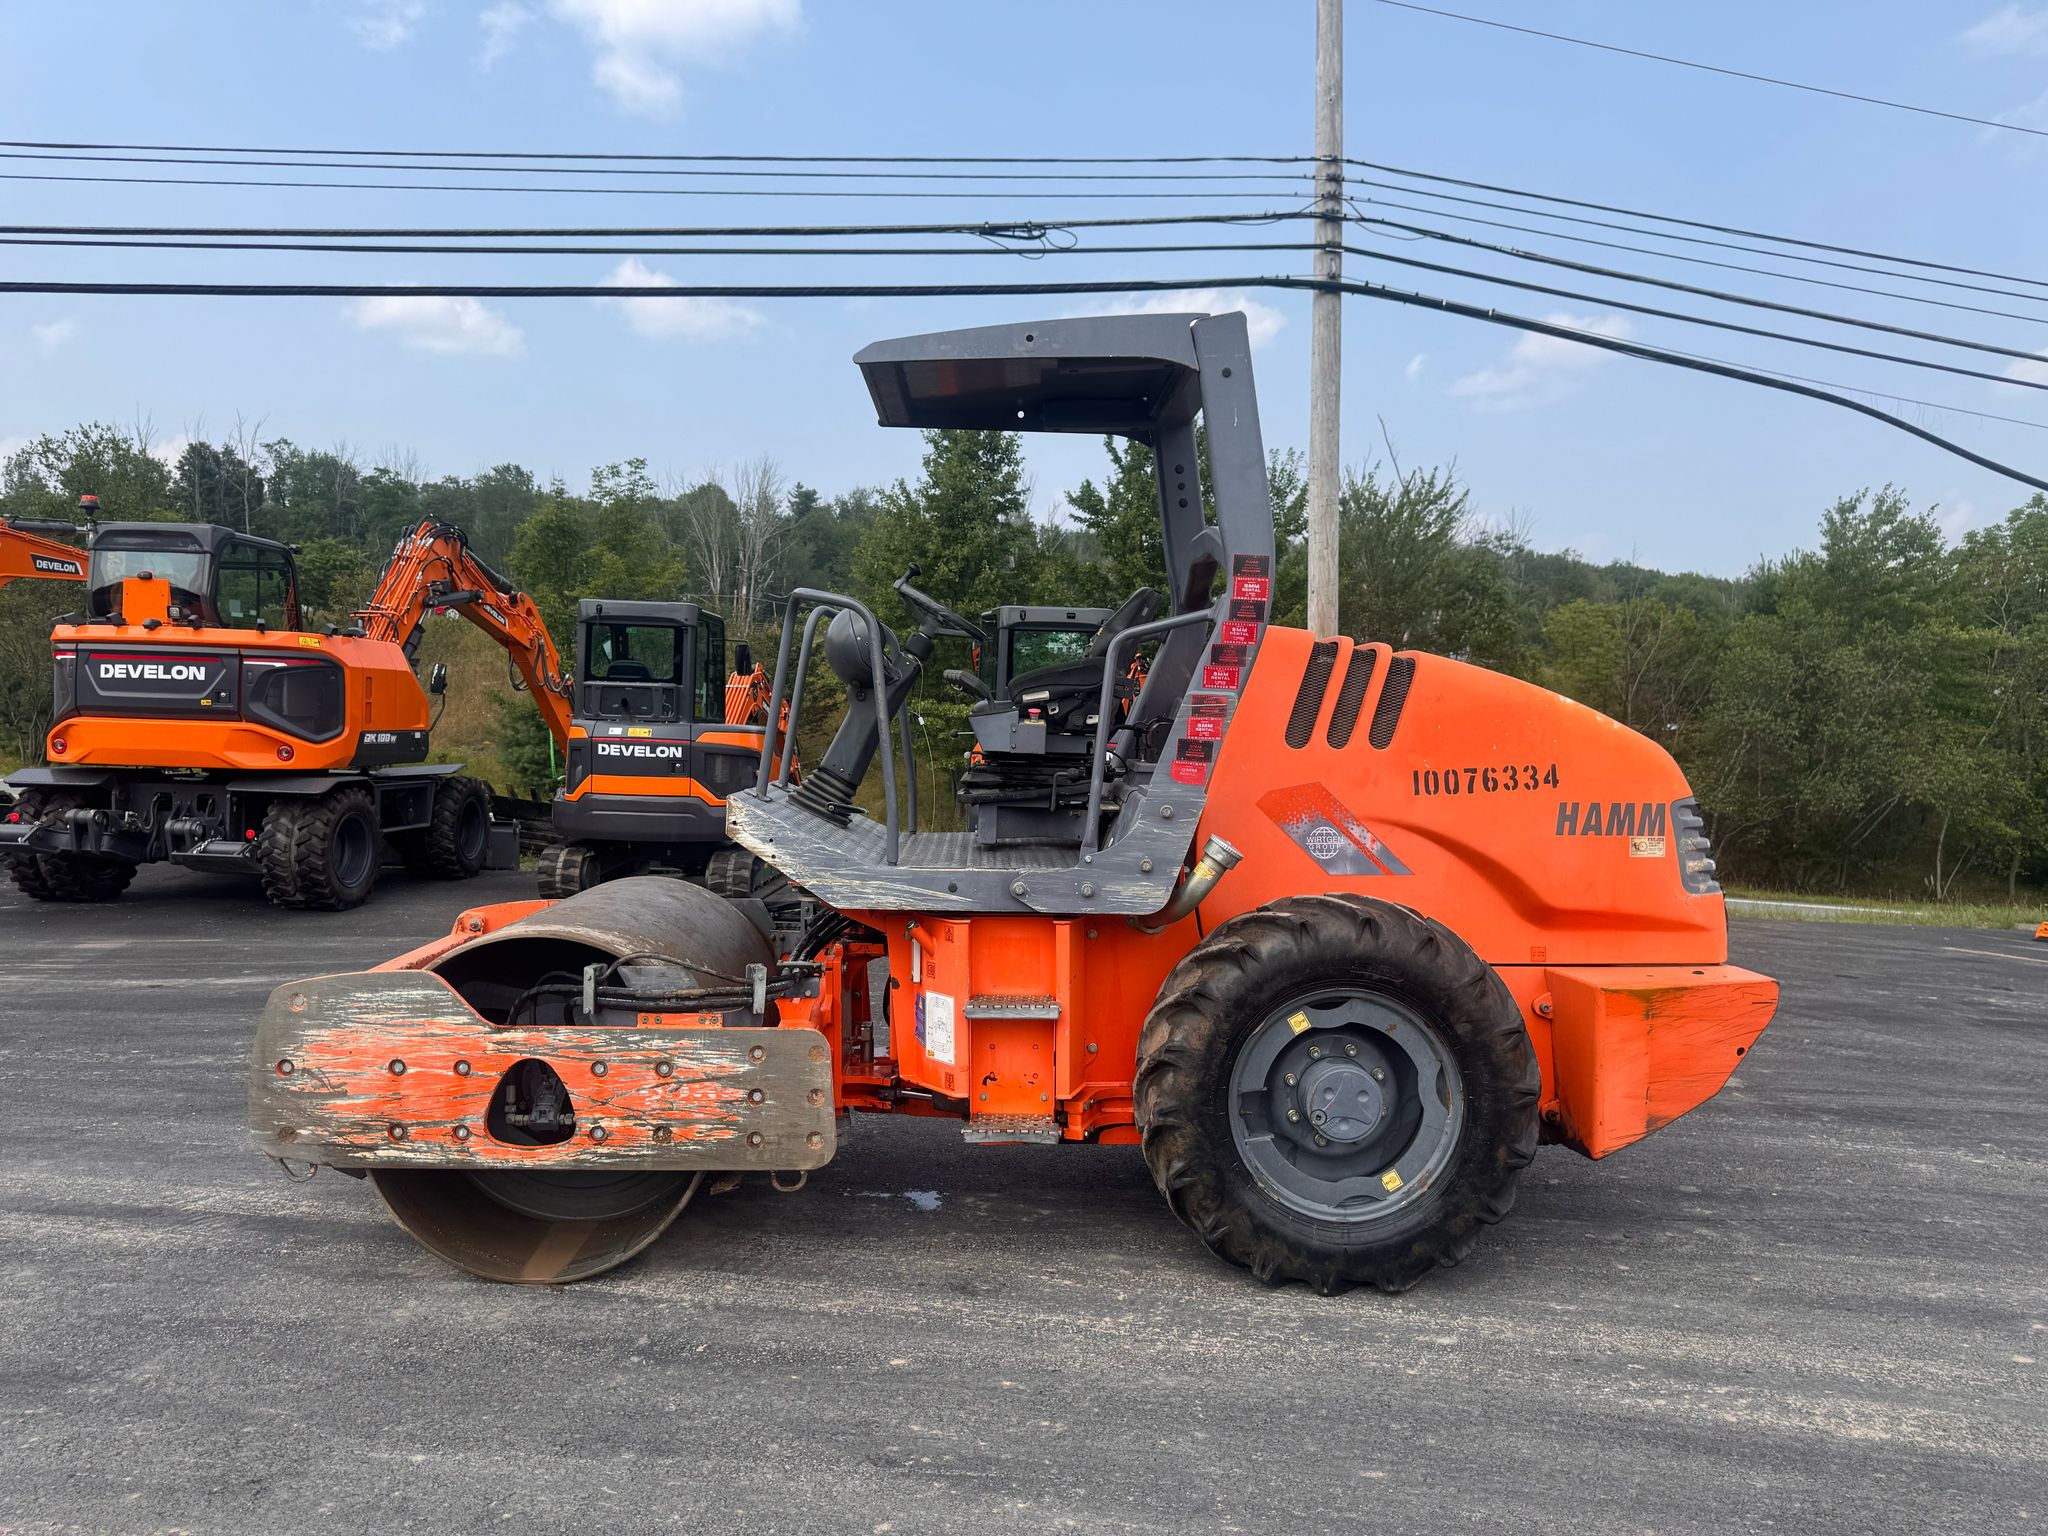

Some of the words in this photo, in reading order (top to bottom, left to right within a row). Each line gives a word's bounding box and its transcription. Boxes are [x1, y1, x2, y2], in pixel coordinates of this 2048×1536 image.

[36, 560, 76, 573] DEVELON
[100, 663, 206, 681] DEVELON
[597, 743, 683, 759] DEVELON
[1413, 763, 1560, 796] 10076334
[1555, 802, 1667, 837] HAMM
[1308, 843, 1341, 851] GROUP
